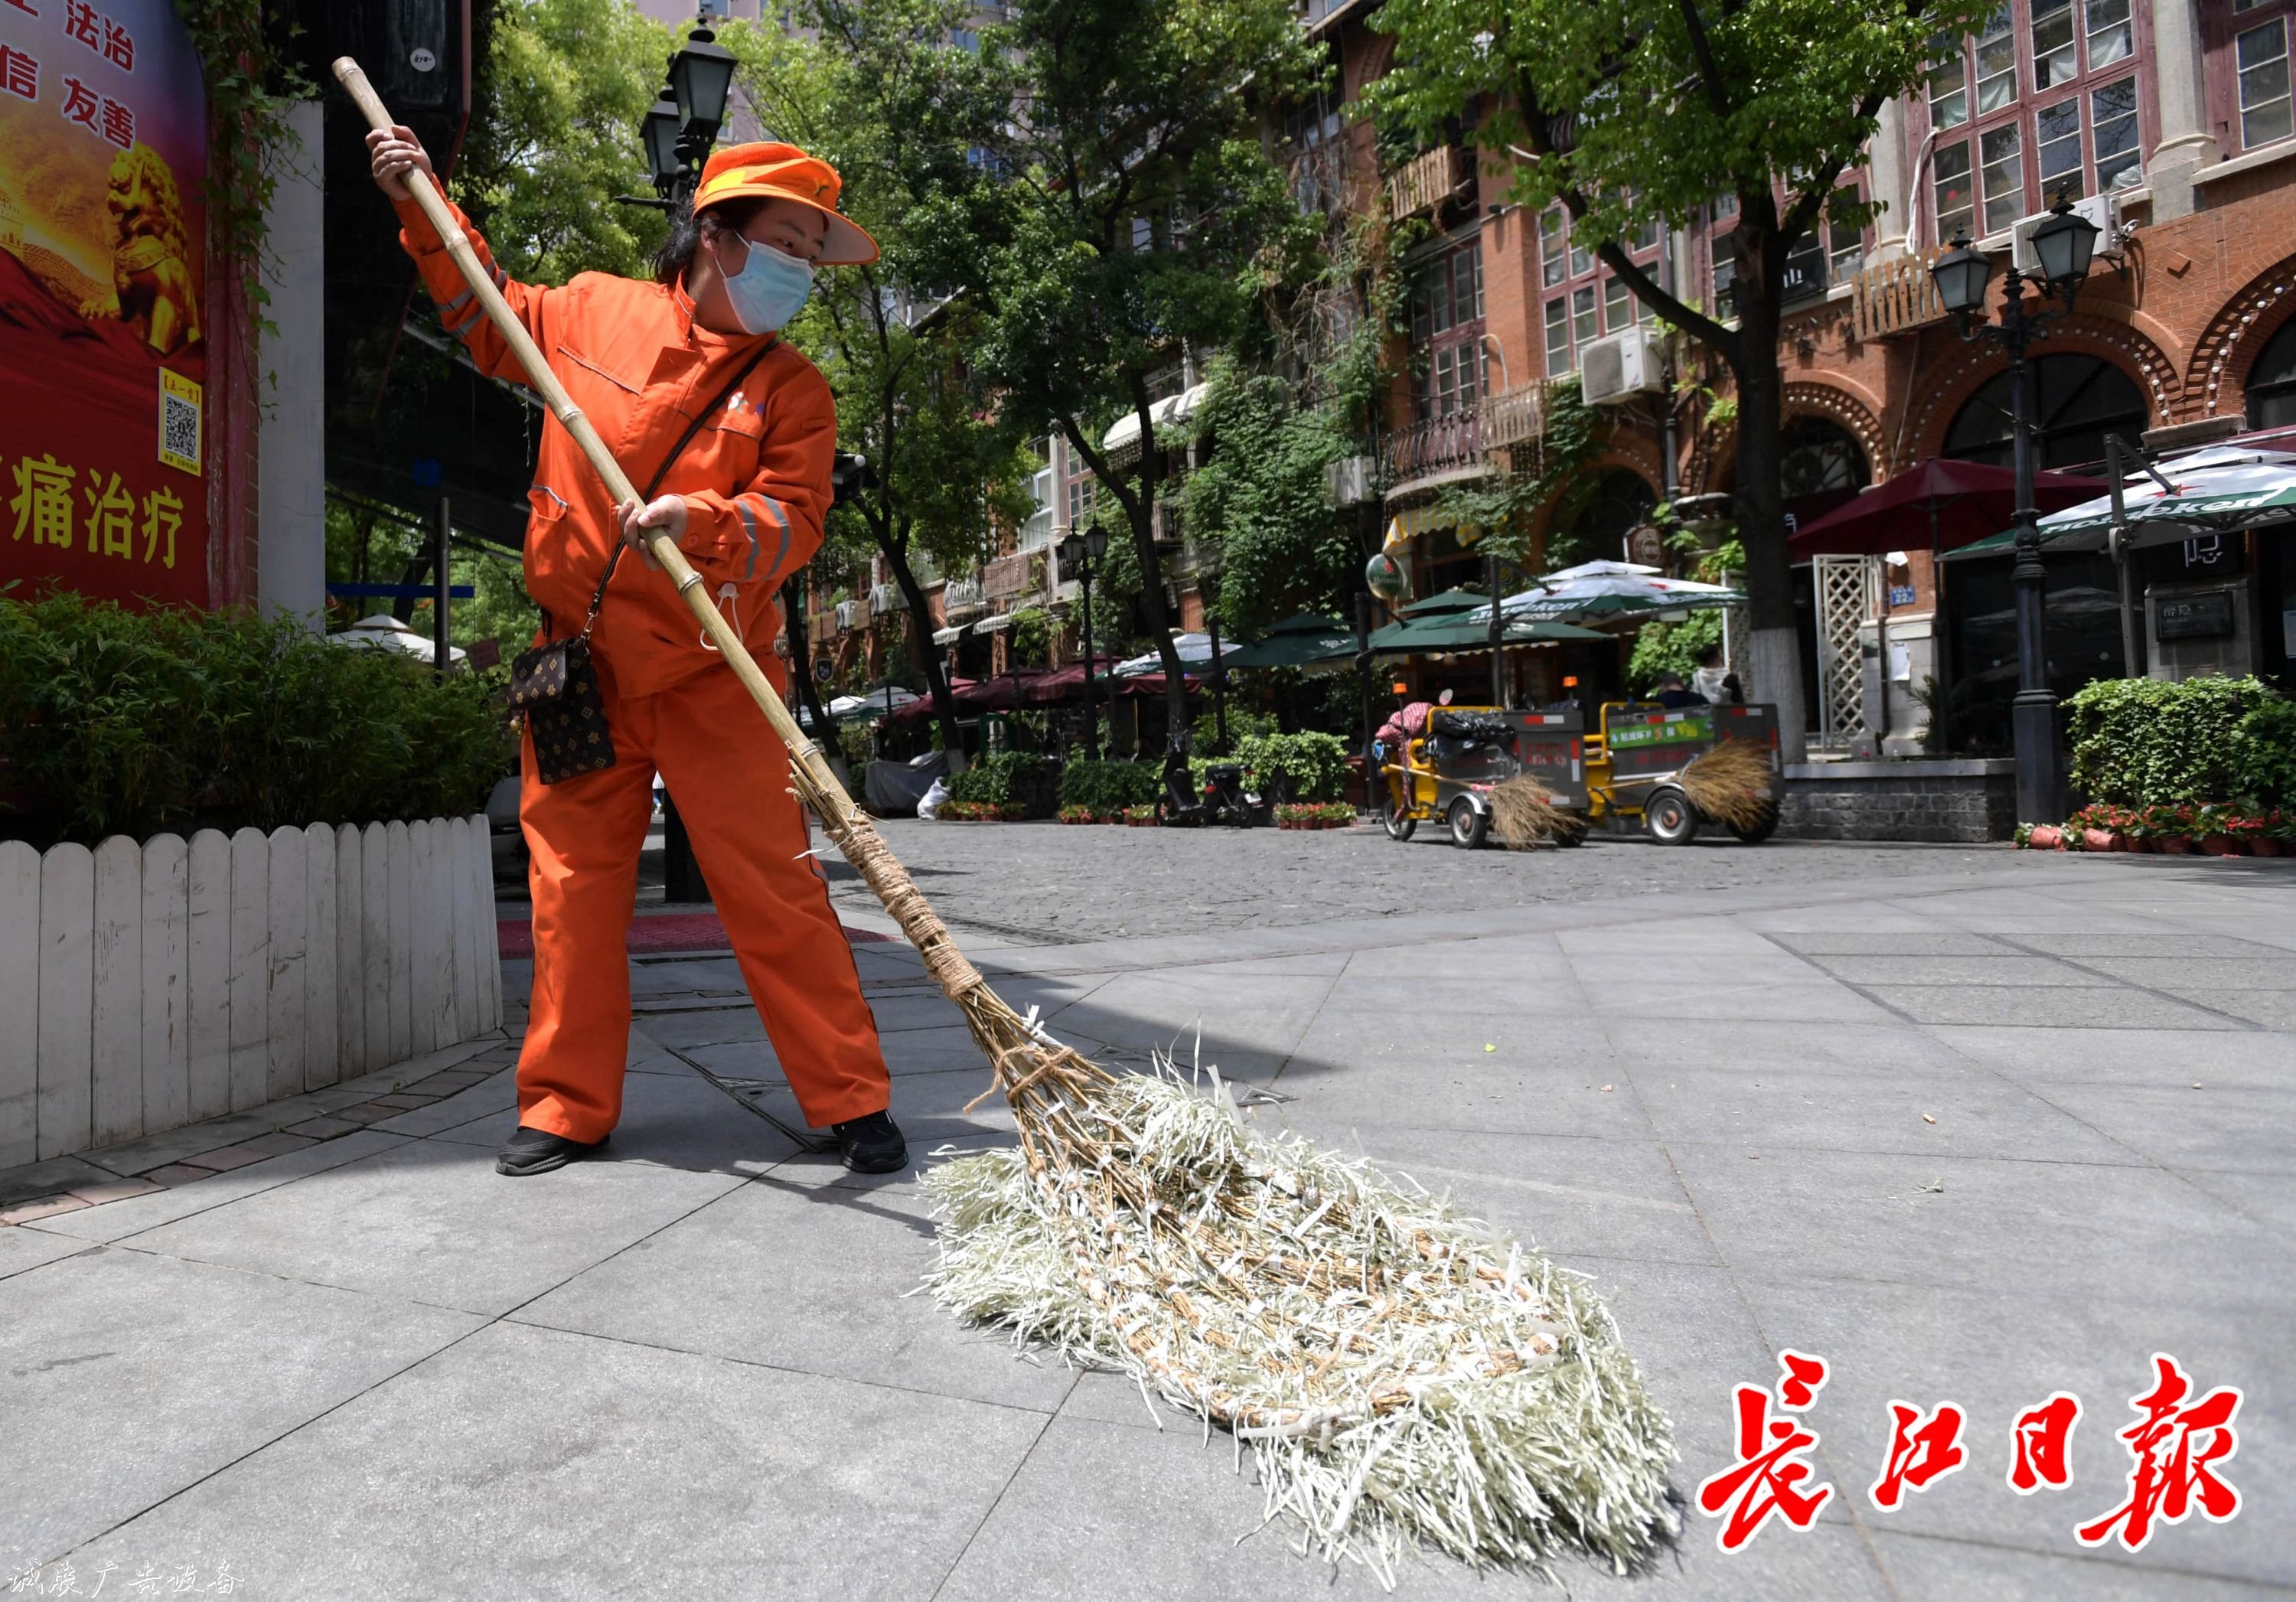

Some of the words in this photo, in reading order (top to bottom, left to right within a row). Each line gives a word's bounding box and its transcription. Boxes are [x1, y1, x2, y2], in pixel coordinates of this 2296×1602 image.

[65, 0, 134, 71] 法治
[0, 44, 38, 100] 信
[64, 77, 134, 150] 友善
[0, 453, 184, 569] 痛治疗
